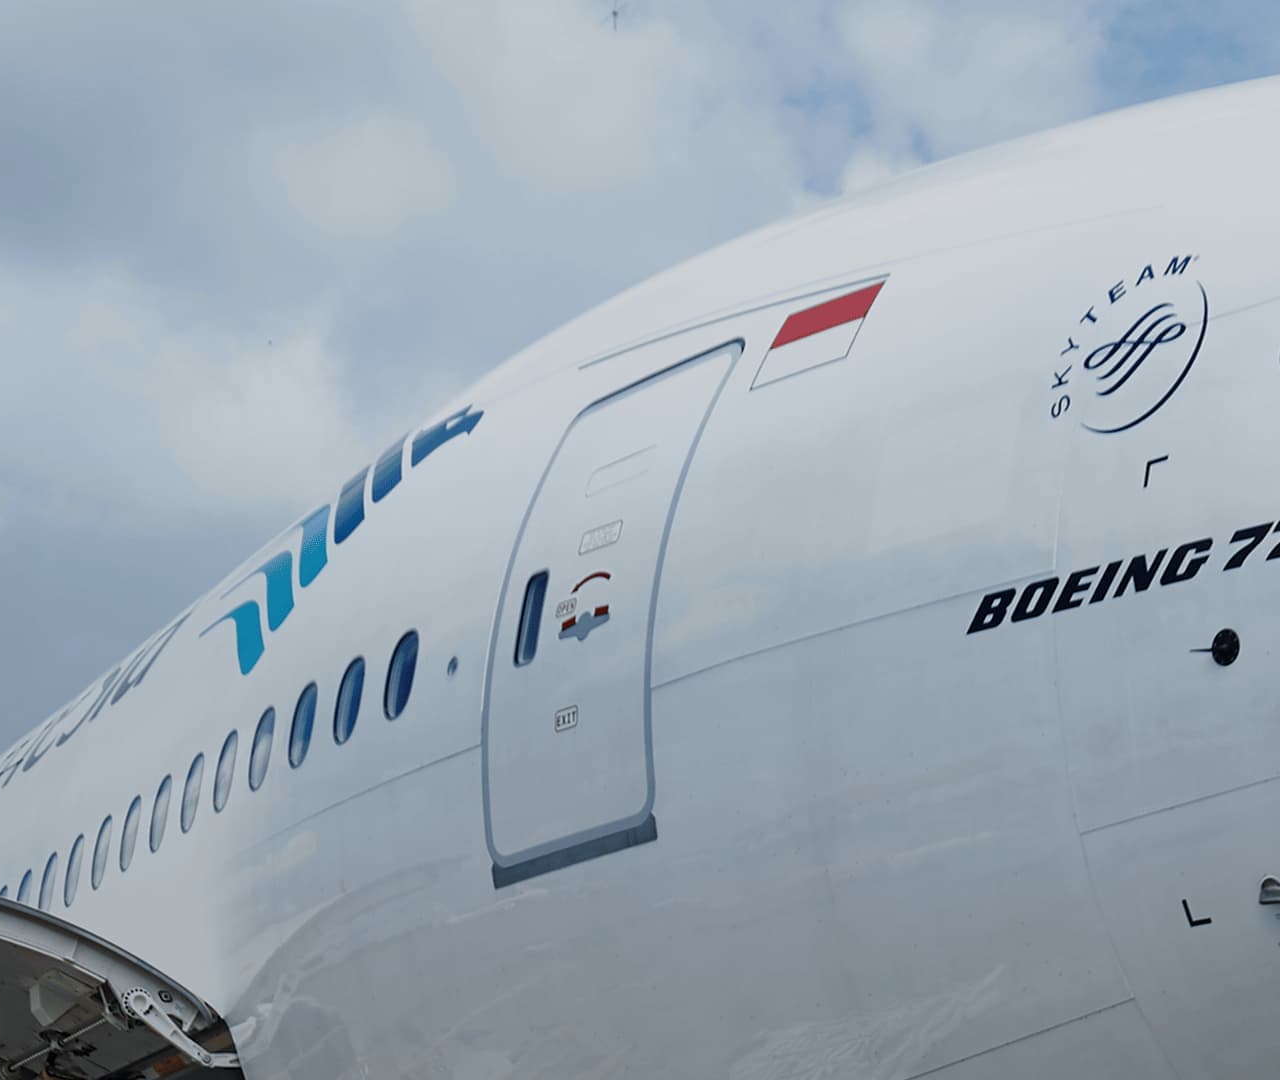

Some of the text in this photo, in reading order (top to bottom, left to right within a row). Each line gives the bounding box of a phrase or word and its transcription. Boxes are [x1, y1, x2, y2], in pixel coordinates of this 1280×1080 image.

[1050, 253, 1194, 419] SKYTEAM
[966, 537, 1214, 635] BOEING
[556, 711, 576, 727] EXIT
